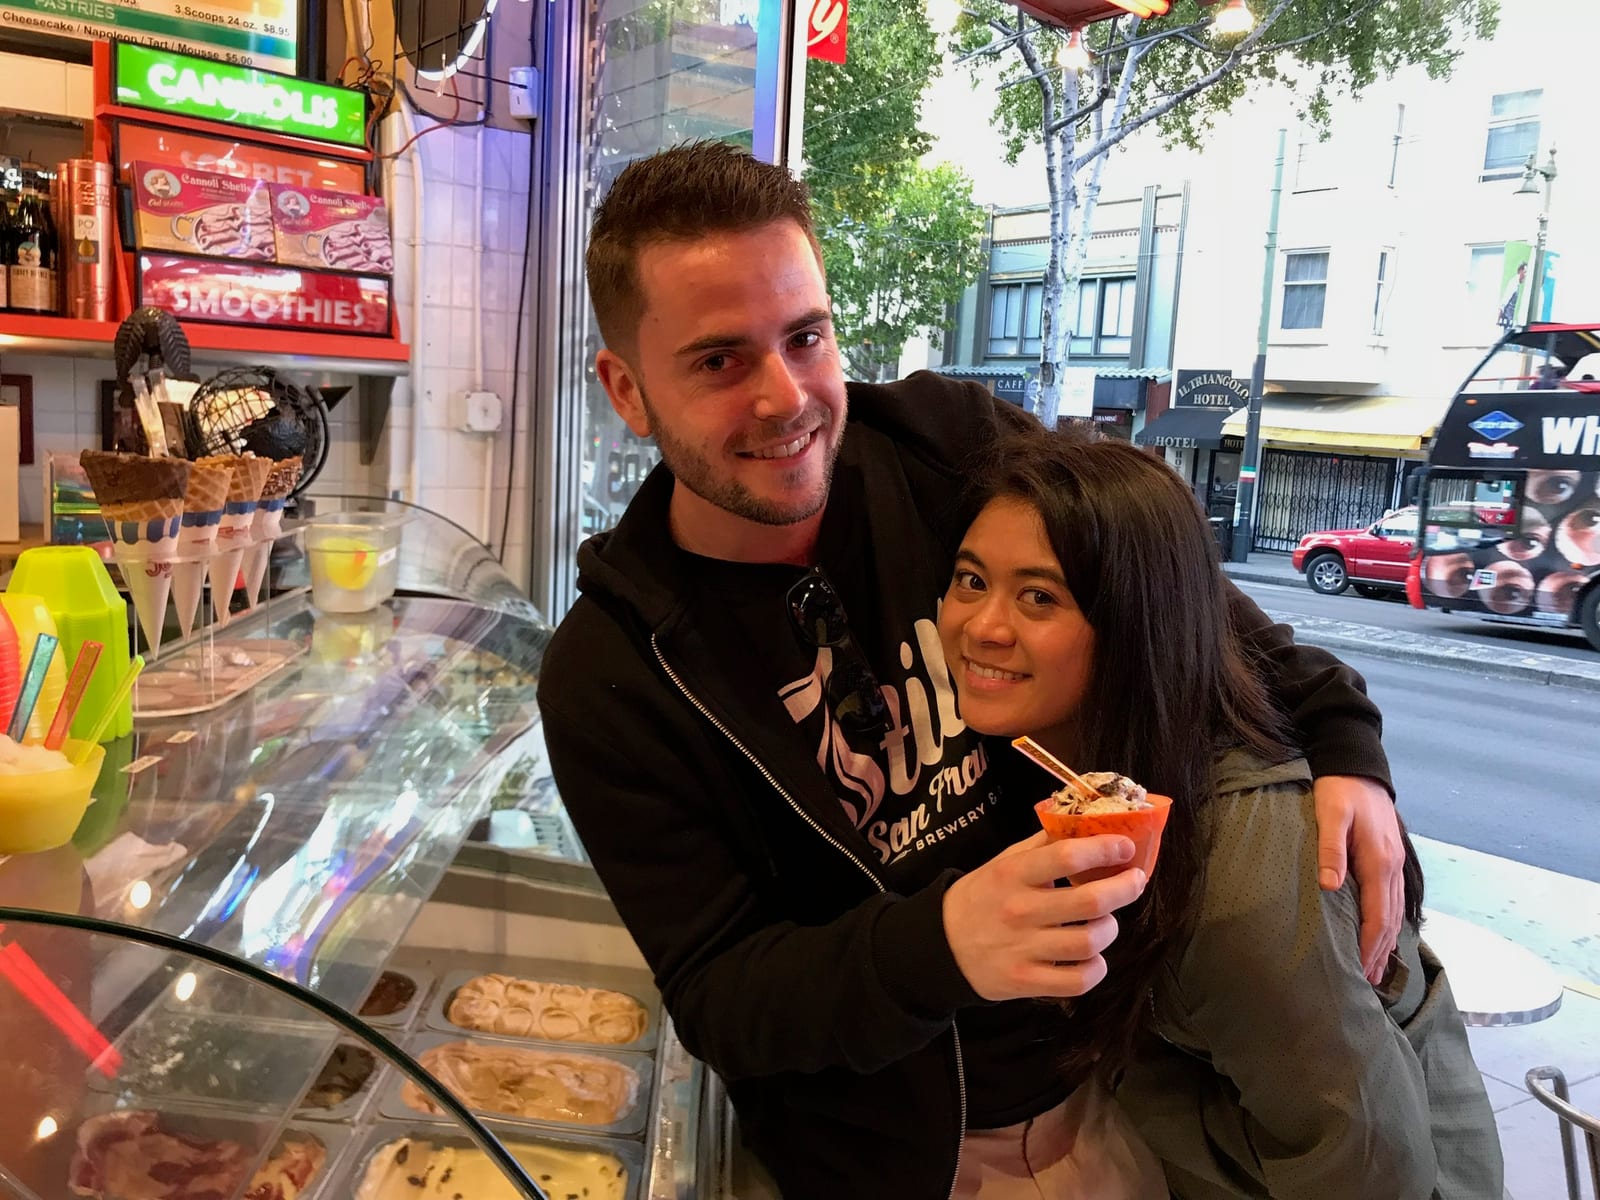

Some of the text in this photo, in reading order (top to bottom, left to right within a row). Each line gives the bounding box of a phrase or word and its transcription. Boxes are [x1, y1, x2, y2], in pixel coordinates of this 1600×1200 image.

[175, 4, 181, 14] 3
[184, 6, 224, 24] Scoops
[227, 15, 240, 25] 24
[2, 11, 74, 32] Cheesecake
[83, 25, 138, 43] Napoleon
[147, 37, 169, 50] Tart
[177, 43, 220, 61] Mousse
[225, 53, 253, 66] $5.00
[147, 64, 339, 128] CANNOLIS
[181, 173, 219, 188] Cannoli
[172, 285, 366, 327] SMOOTHIES
[1178, 373, 1249, 400] IL TRIANGOLO
[1193, 394, 1231, 406] HOTEL
[1155, 436, 1198, 449] HOTEL
[868, 803, 931, 865] San
[916, 803, 985, 851] BREWERY
